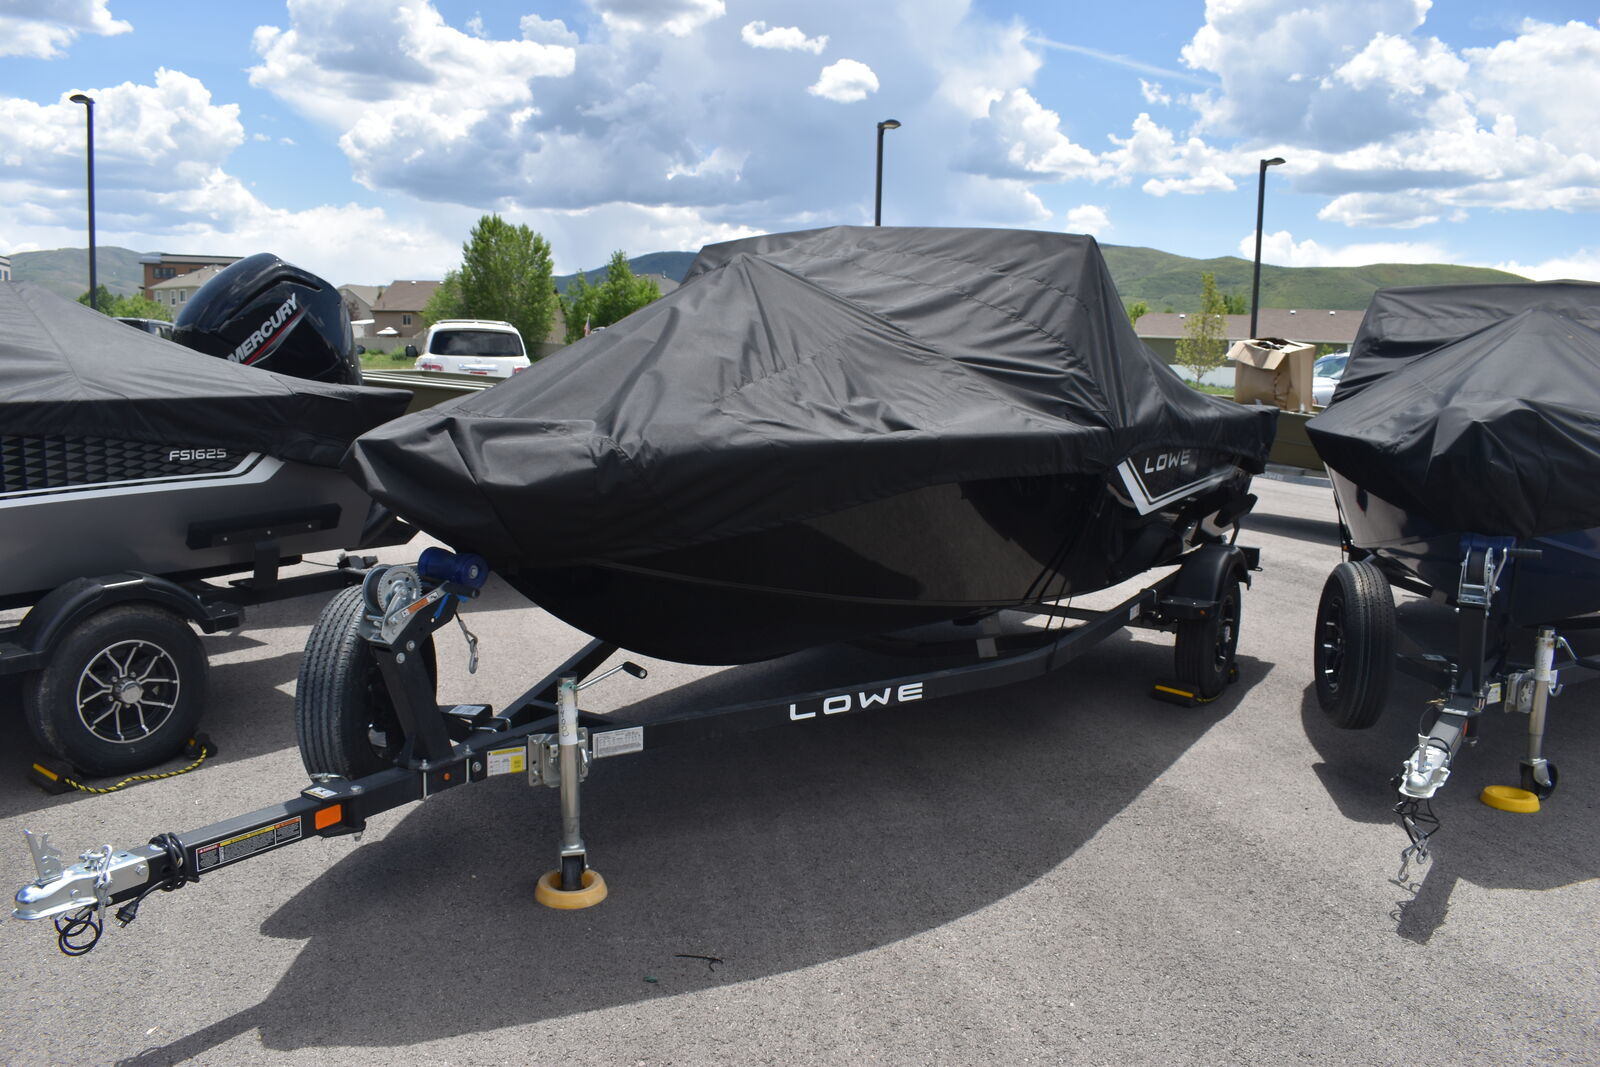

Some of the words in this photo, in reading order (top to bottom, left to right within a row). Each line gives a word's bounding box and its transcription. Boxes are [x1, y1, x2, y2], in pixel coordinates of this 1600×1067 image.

[227, 292, 297, 363] MERCURY
[169, 449, 227, 461] FS1625
[1144, 449, 1191, 474] LOWE
[789, 682, 923, 720] LOWE
